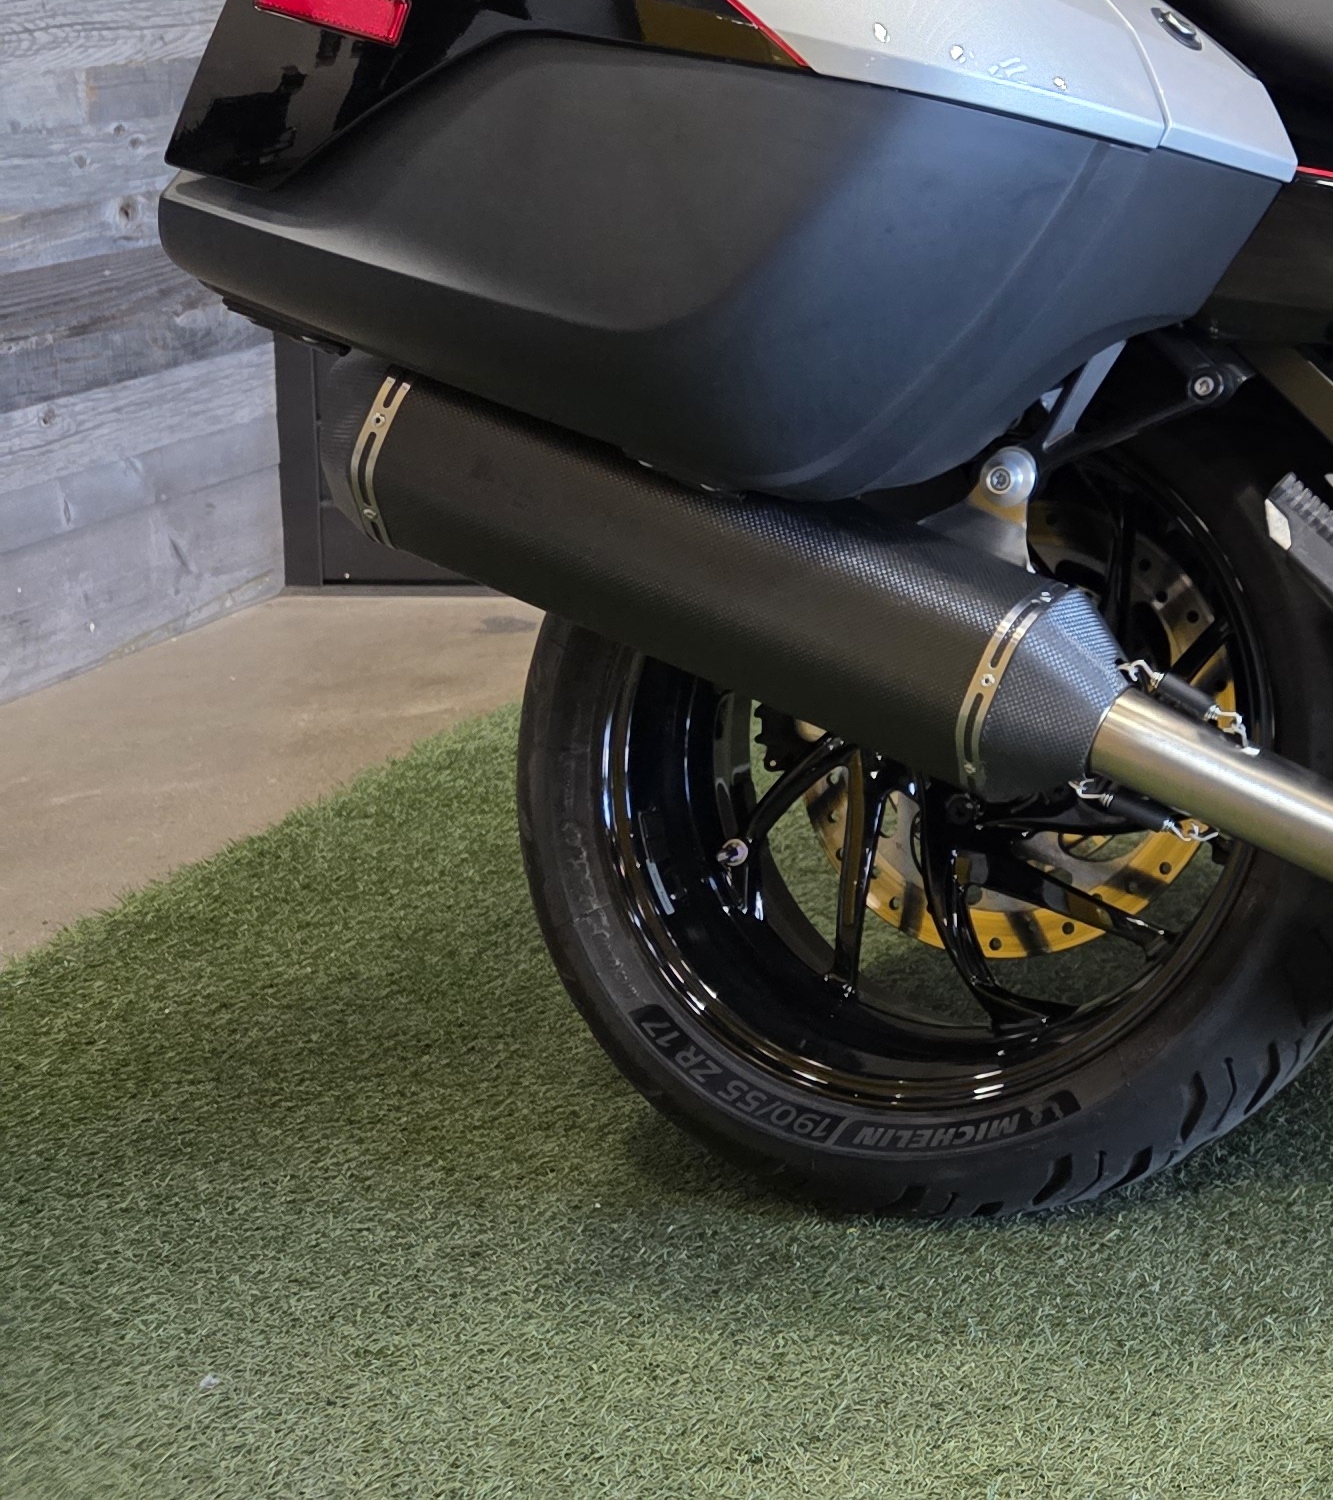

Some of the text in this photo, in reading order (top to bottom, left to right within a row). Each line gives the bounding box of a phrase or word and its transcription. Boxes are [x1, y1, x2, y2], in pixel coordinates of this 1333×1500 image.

[640, 1020, 1021, 1150] MICHELIN 190/55 ZR 17
